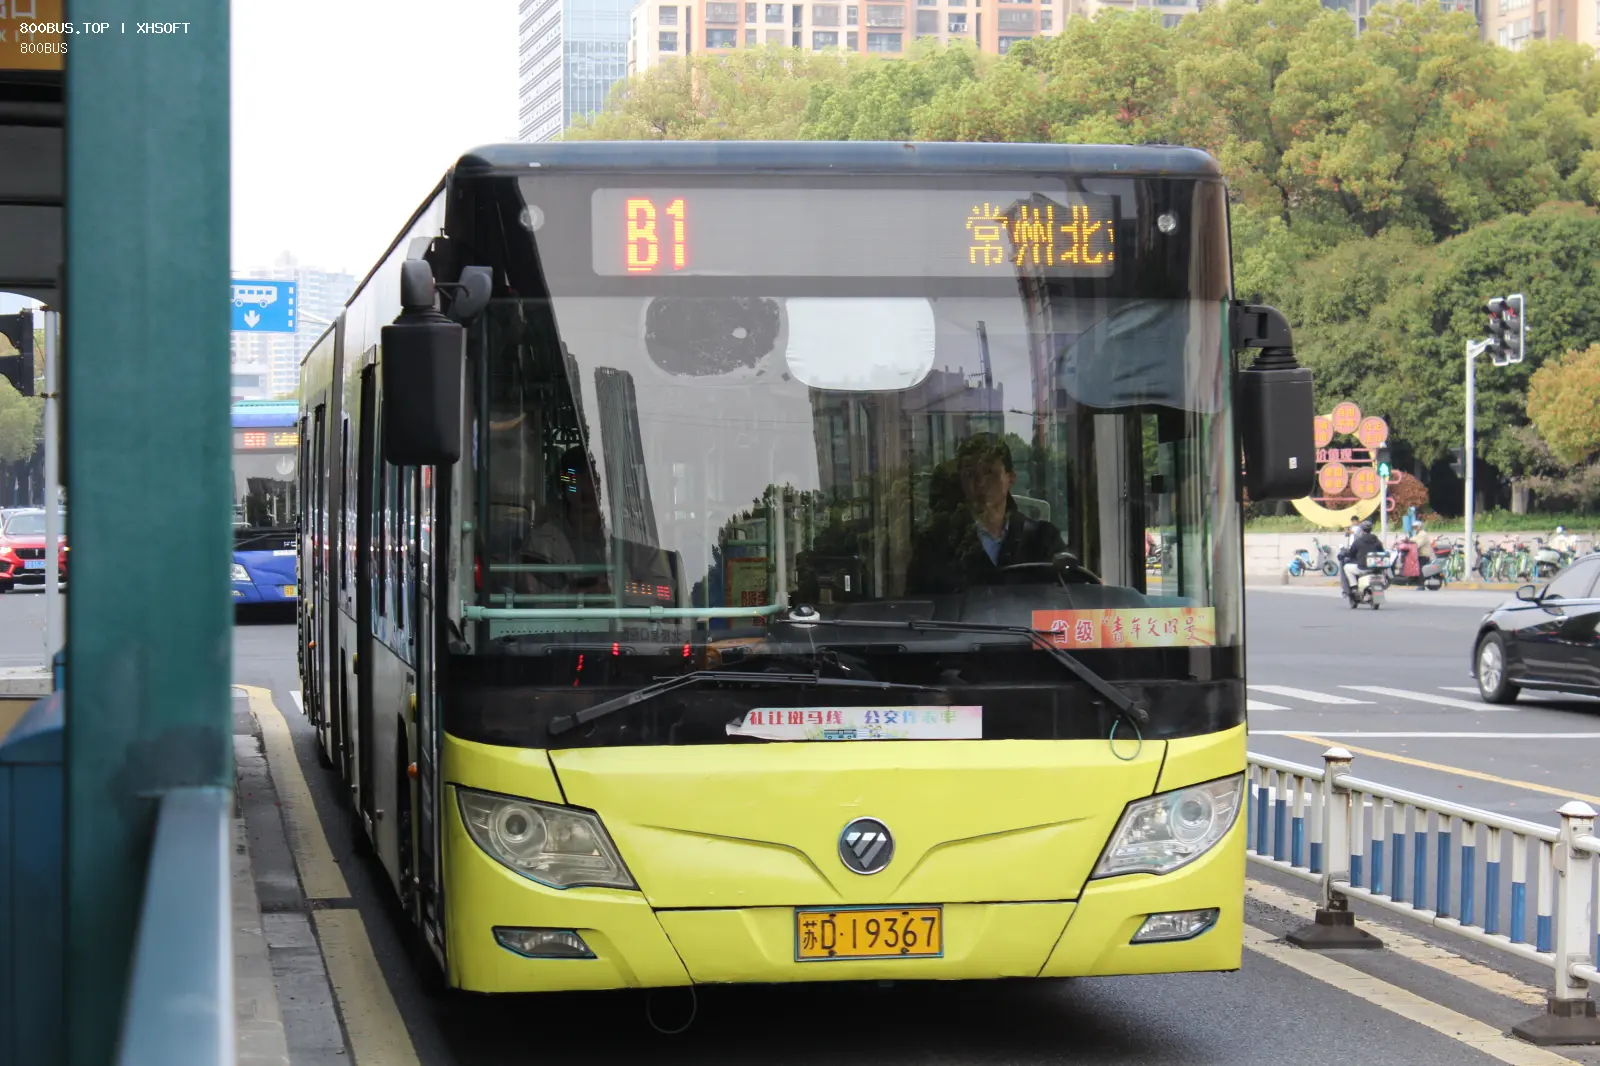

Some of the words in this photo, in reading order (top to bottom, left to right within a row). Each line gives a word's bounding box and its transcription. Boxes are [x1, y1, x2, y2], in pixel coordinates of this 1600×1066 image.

[626, 198, 685, 271] B1
[966, 203, 1115, 266] 常州北
[749, 710, 843, 726] 礼让斑马线
